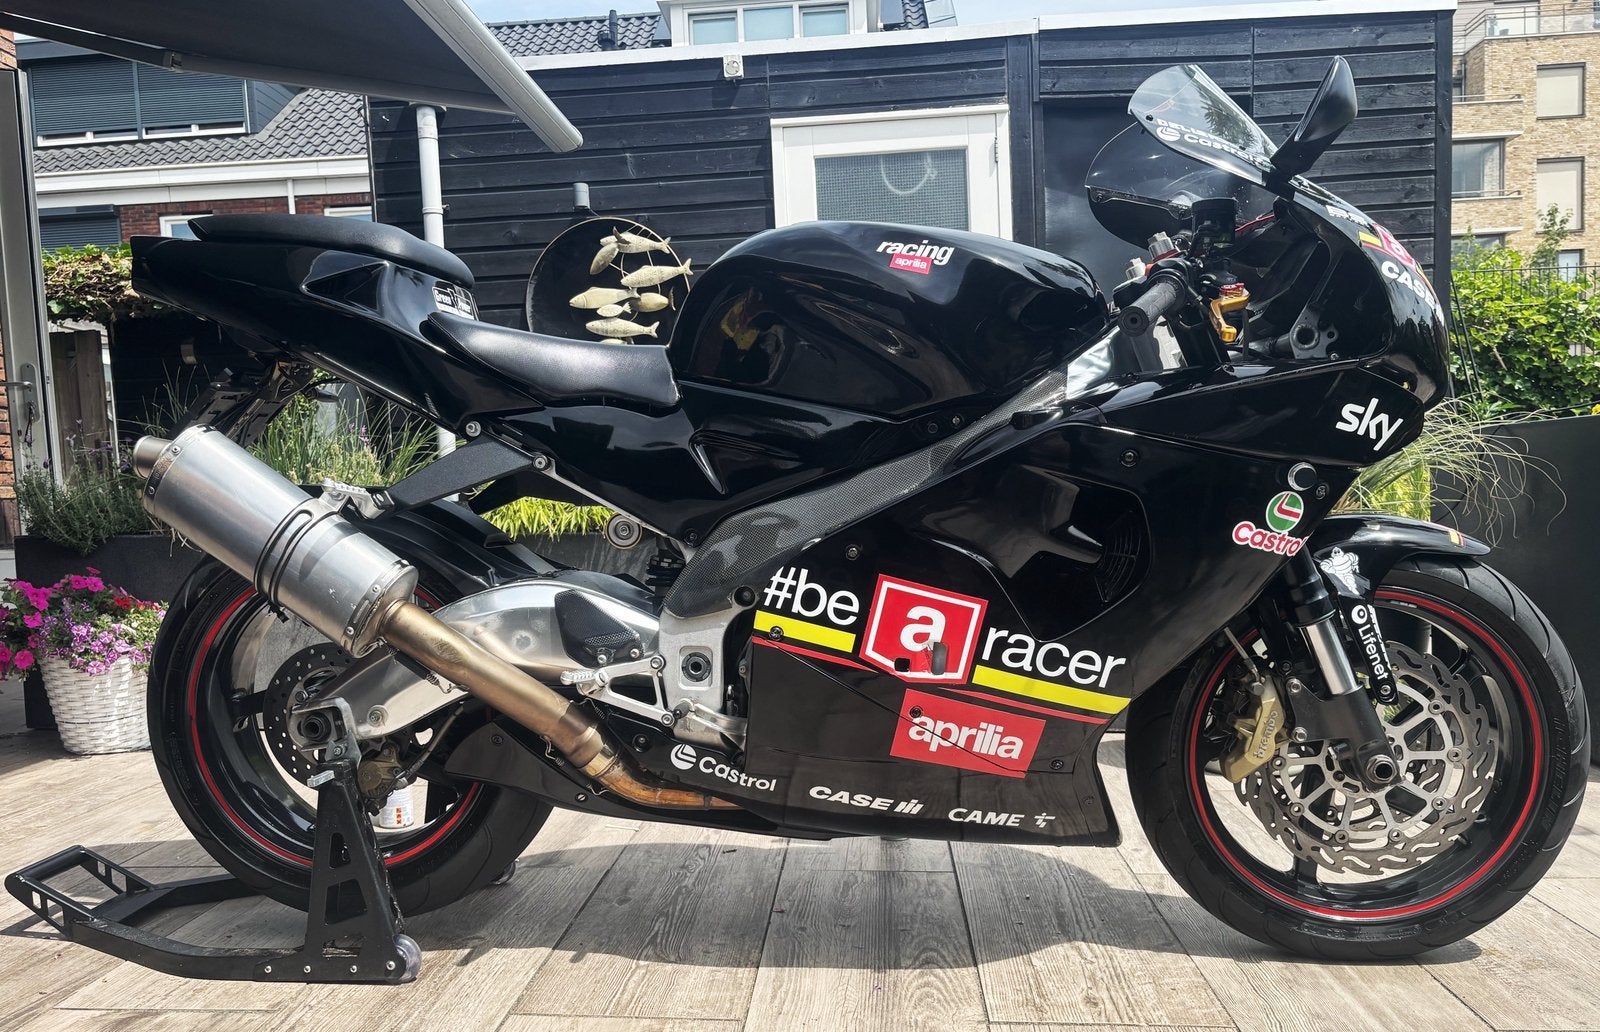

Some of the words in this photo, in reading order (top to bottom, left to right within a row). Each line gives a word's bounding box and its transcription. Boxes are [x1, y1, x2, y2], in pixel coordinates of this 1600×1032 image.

[876, 240, 955, 266] racing
[895, 257, 928, 270] aprilia
[1335, 397, 1404, 452] sky
[763, 566, 860, 627] #be
[899, 605, 947, 653] a
[981, 626, 1127, 689] racer
[1358, 624, 1389, 680] Lifenet
[908, 715, 1025, 760] aprilia
[1252, 709, 1279, 760] brembo
[698, 756, 777, 792] Castrol
[809, 785, 895, 811] CASE
[948, 807, 1025, 827] CAME
